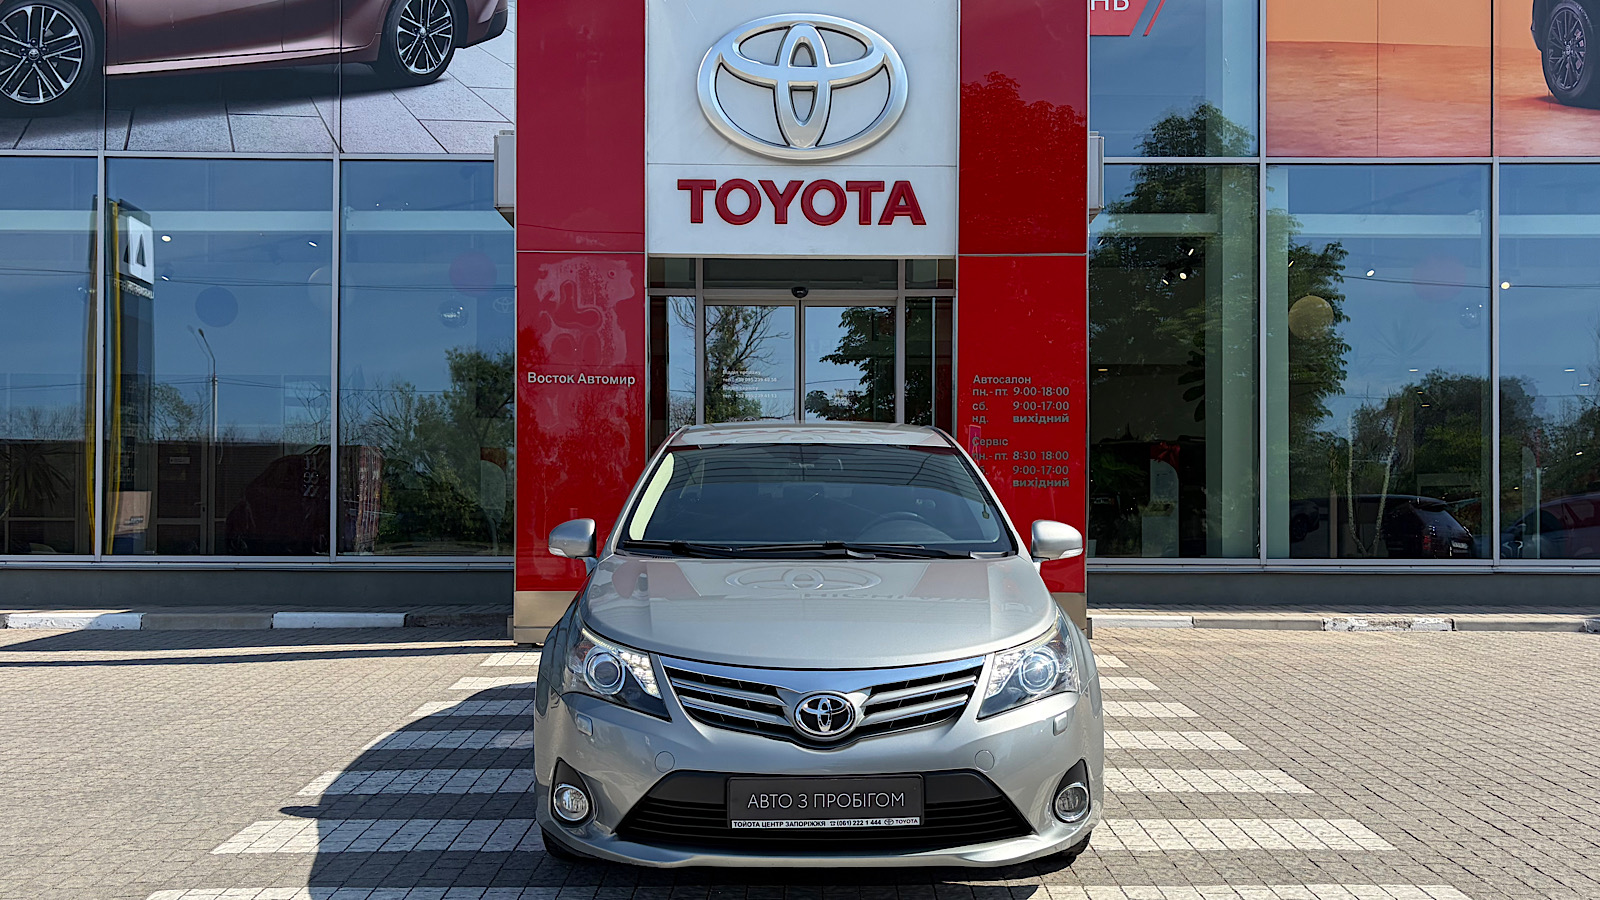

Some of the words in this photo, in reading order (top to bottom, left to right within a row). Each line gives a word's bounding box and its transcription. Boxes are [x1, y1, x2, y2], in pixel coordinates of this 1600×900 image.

[677, 178, 927, 226] TOYOTA
[527, 372, 575, 384] Восток
[577, 373, 636, 388] Автомир
[973, 375, 1031, 384] Автосалон
[972, 401, 988, 410] сб.
[1013, 401, 1070, 410] 9:00-17:00
[972, 415, 989, 424] нд.
[1013, 413, 1070, 424] вихідний
[972, 436, 1009, 448] Сервіс
[1013, 451, 1036, 460] 8:30
[1041, 451, 1069, 460] 18:00
[1013, 465, 1069, 475] 9:00-17:00
[1013, 477, 1070, 488] вихідний
[747, 793, 793, 808] АВТО
[813, 792, 905, 808] ПРОБІГОМ
